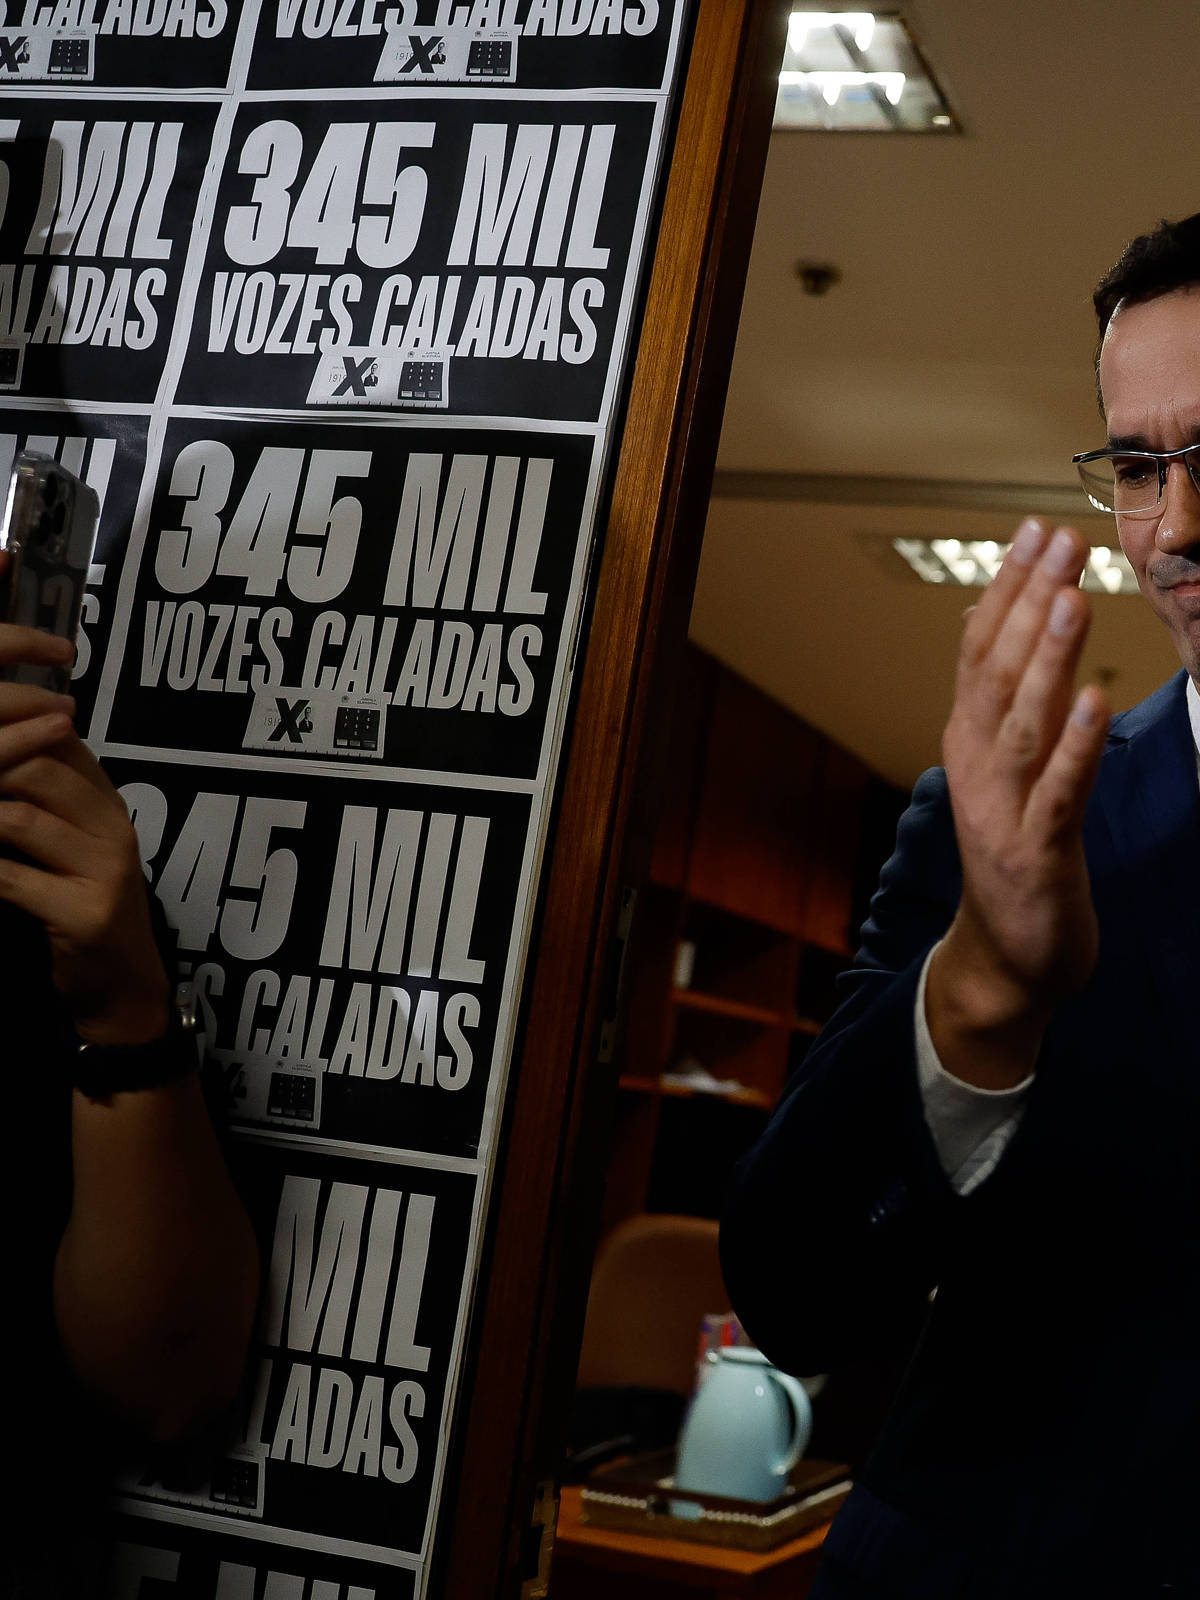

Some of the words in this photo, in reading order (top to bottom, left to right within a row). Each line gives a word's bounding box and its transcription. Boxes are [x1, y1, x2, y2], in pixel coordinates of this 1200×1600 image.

[24, 120, 184, 260] MIL
[223, 119, 436, 268] 345
[446, 123, 616, 269] MIL
[207, 271, 363, 355] VOZES
[373, 275, 606, 364] CALADAS
[154, 440, 372, 603] 345
[383, 452, 554, 615] MIL
[139, 600, 293, 694] VOZES
[302, 610, 544, 717] CALADAS
[318, 804, 491, 984] MIL
[234, 969, 481, 1091] CALADAS
[262, 1174, 437, 1373] MIL
